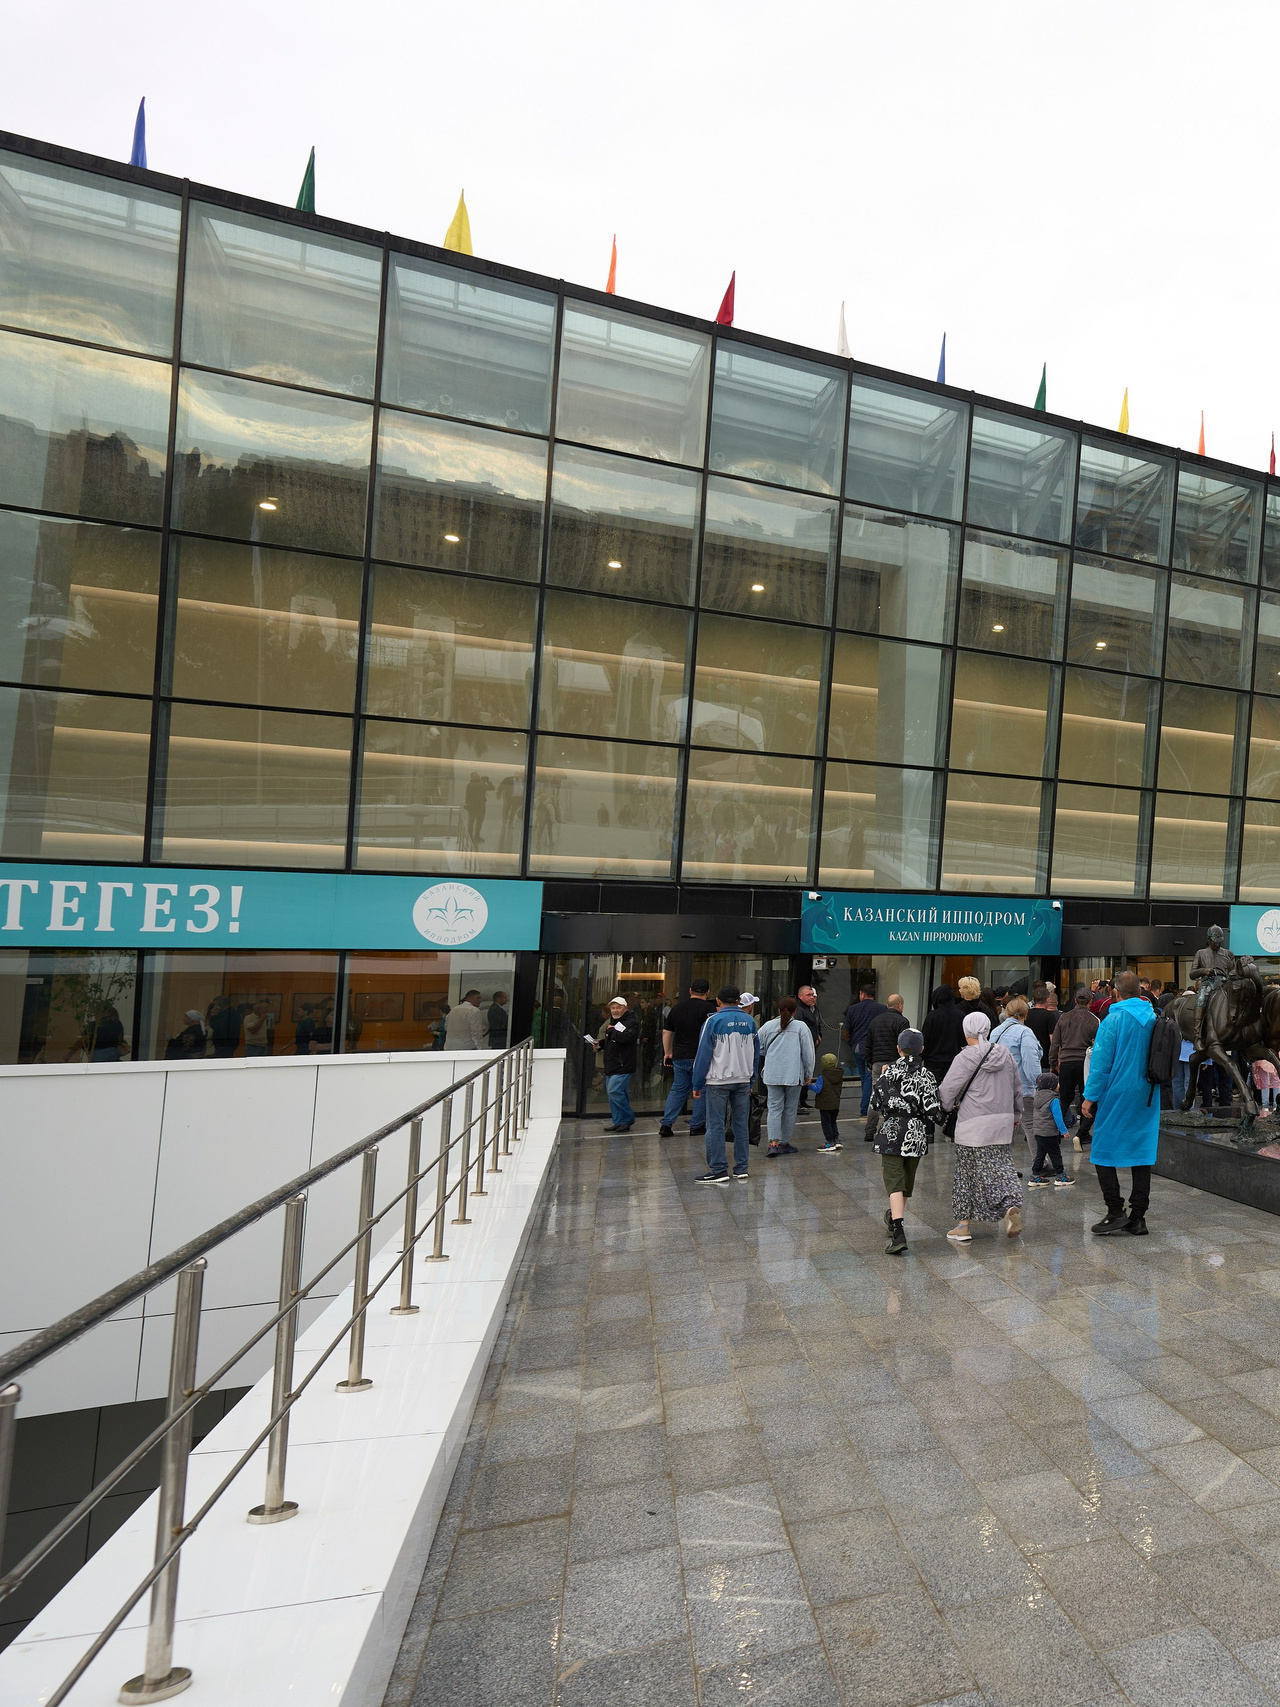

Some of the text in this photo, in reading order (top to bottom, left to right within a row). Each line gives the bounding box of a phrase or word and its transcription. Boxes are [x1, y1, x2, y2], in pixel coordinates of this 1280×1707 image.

[0, 879, 244, 933] ТЕГЕЗ!
[843, 906, 1026, 927] КАЗАНСКИЙ ИППОДРОМ
[424, 928, 476, 943] ИППОДРОМ
[889, 930, 984, 943] KAZAN HIPPODROME
